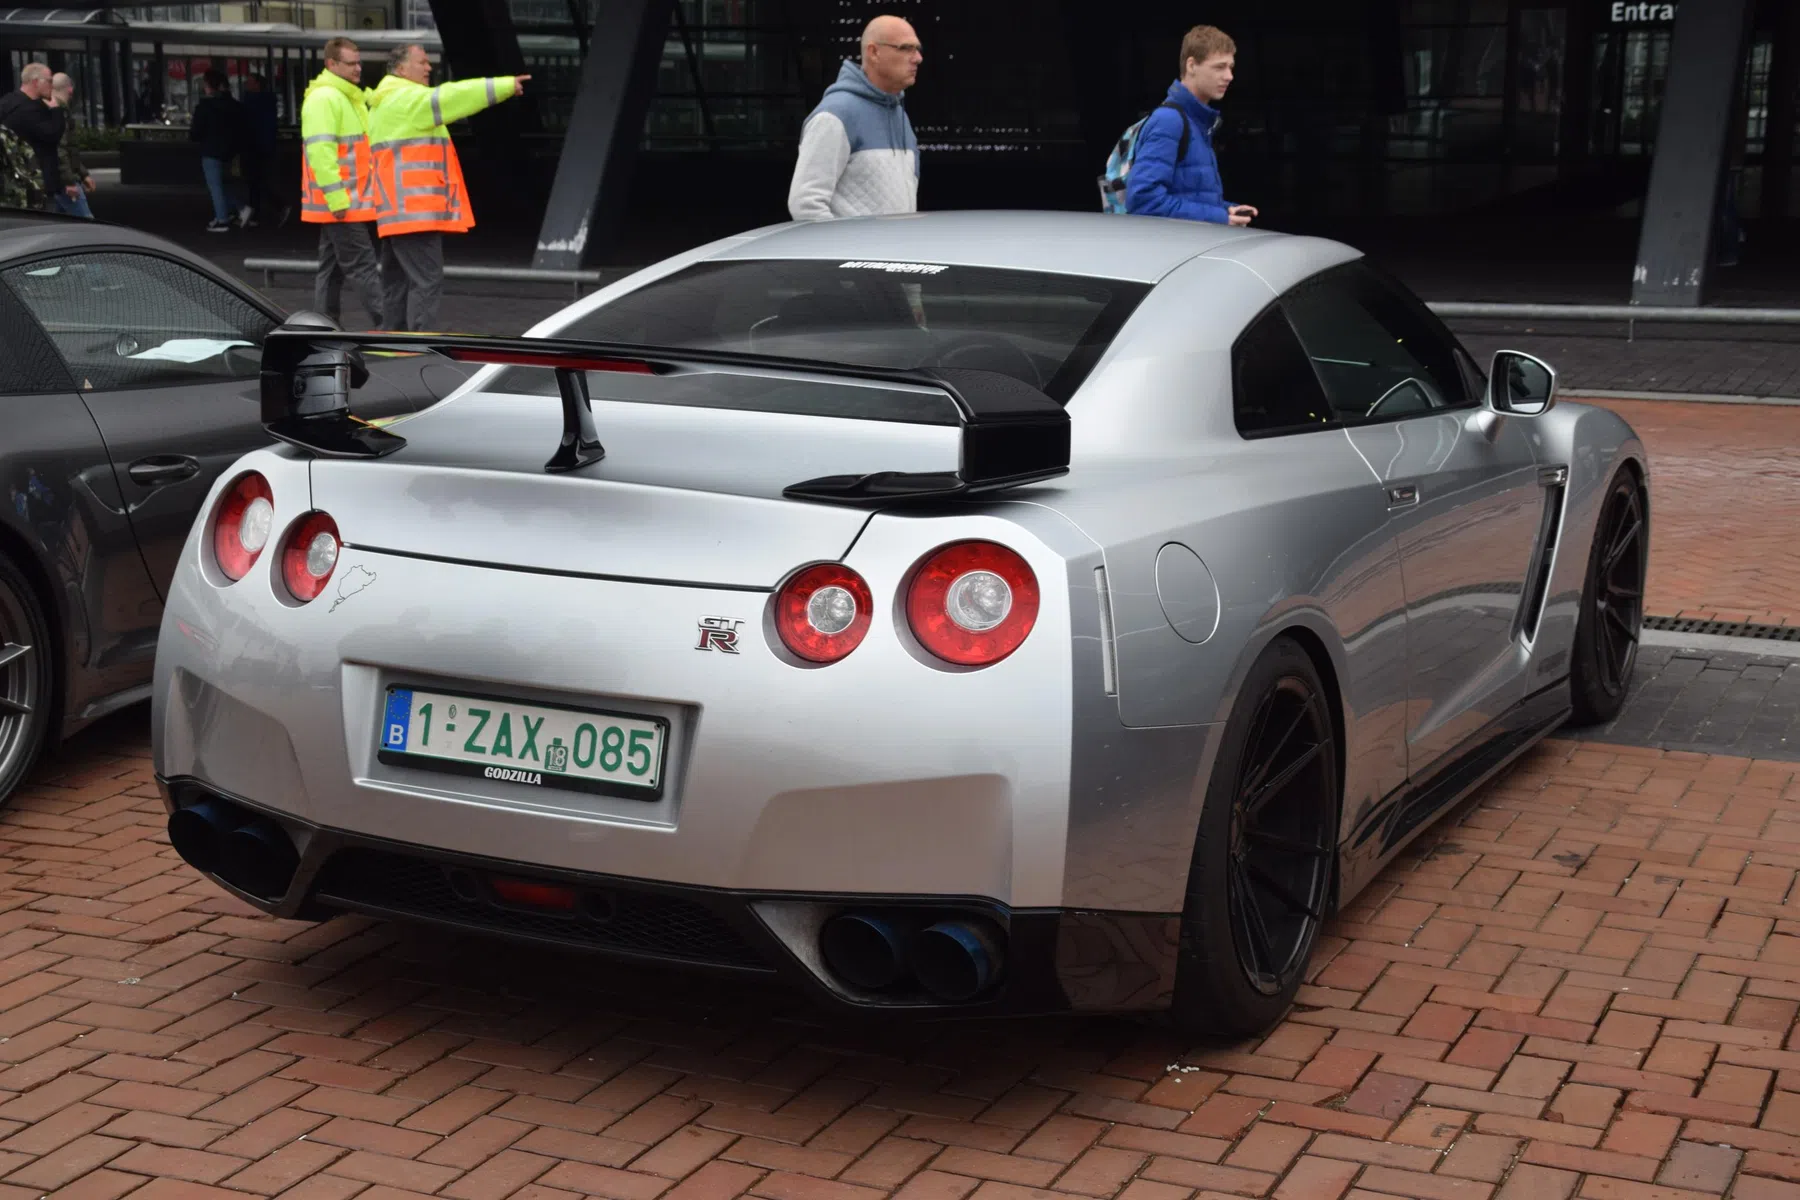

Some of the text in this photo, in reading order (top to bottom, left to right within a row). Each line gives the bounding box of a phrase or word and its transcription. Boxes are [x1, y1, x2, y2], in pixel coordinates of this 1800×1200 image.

[1611, 1, 1678, 21] Entra
[388, 723, 404, 745] B
[484, 766, 542, 786] GODZILLA
